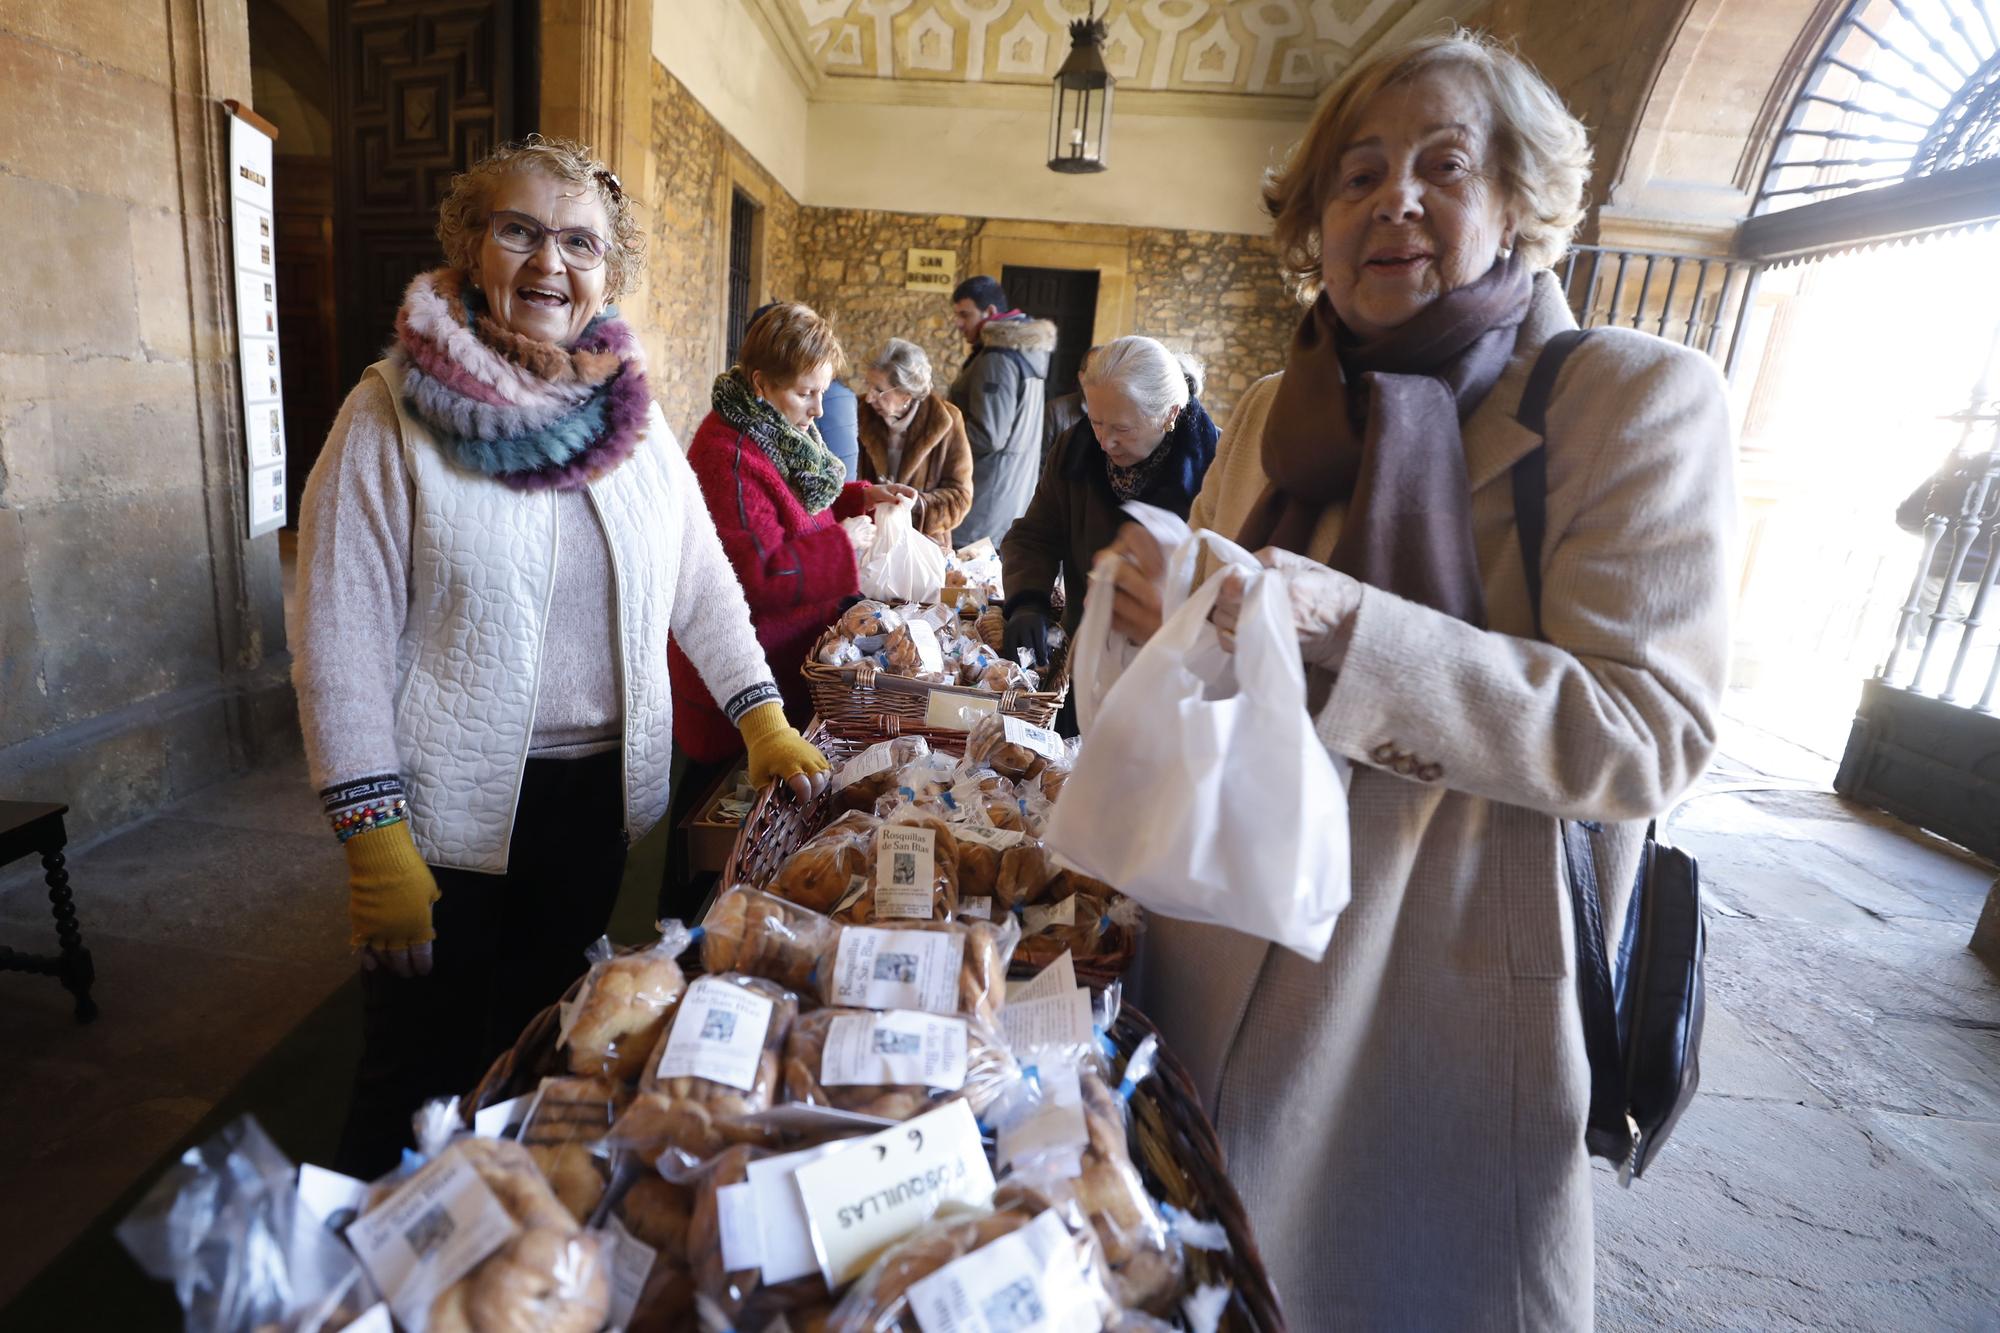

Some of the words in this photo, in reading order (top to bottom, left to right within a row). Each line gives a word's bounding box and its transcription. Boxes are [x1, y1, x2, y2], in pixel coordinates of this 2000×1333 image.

[919, 256, 943, 268] SAN
[883, 829, 926, 842] Rosquillas
[882, 842, 891, 850] de
[893, 841, 910, 850] San
[911, 842, 929, 853] Blas
[907, 1128, 924, 1154] 6
